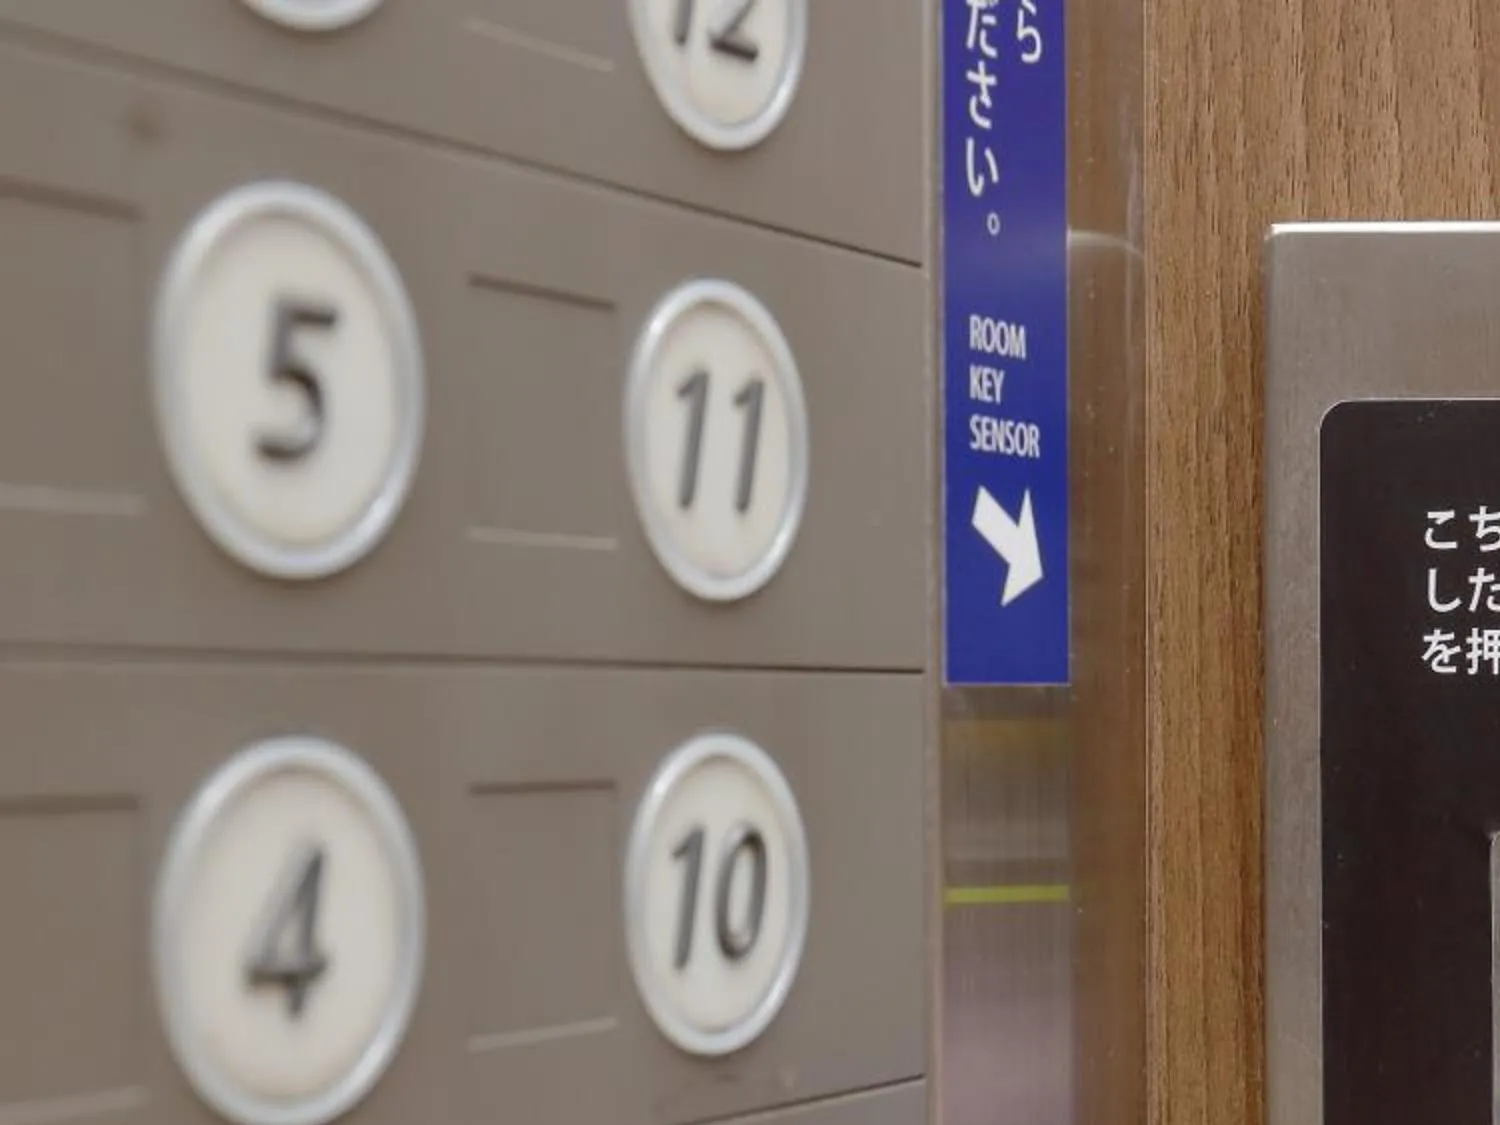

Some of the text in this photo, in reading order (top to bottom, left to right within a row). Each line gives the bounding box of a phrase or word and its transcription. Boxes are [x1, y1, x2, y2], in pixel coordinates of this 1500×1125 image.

[252, 298, 339, 467] 5
[969, 313, 1027, 361] ROOM
[969, 363, 1005, 405] KEY
[674, 367, 764, 516] 11
[969, 413, 1041, 460] SENSOR
[242, 843, 328, 1020] 4
[670, 822, 769, 972] 10
